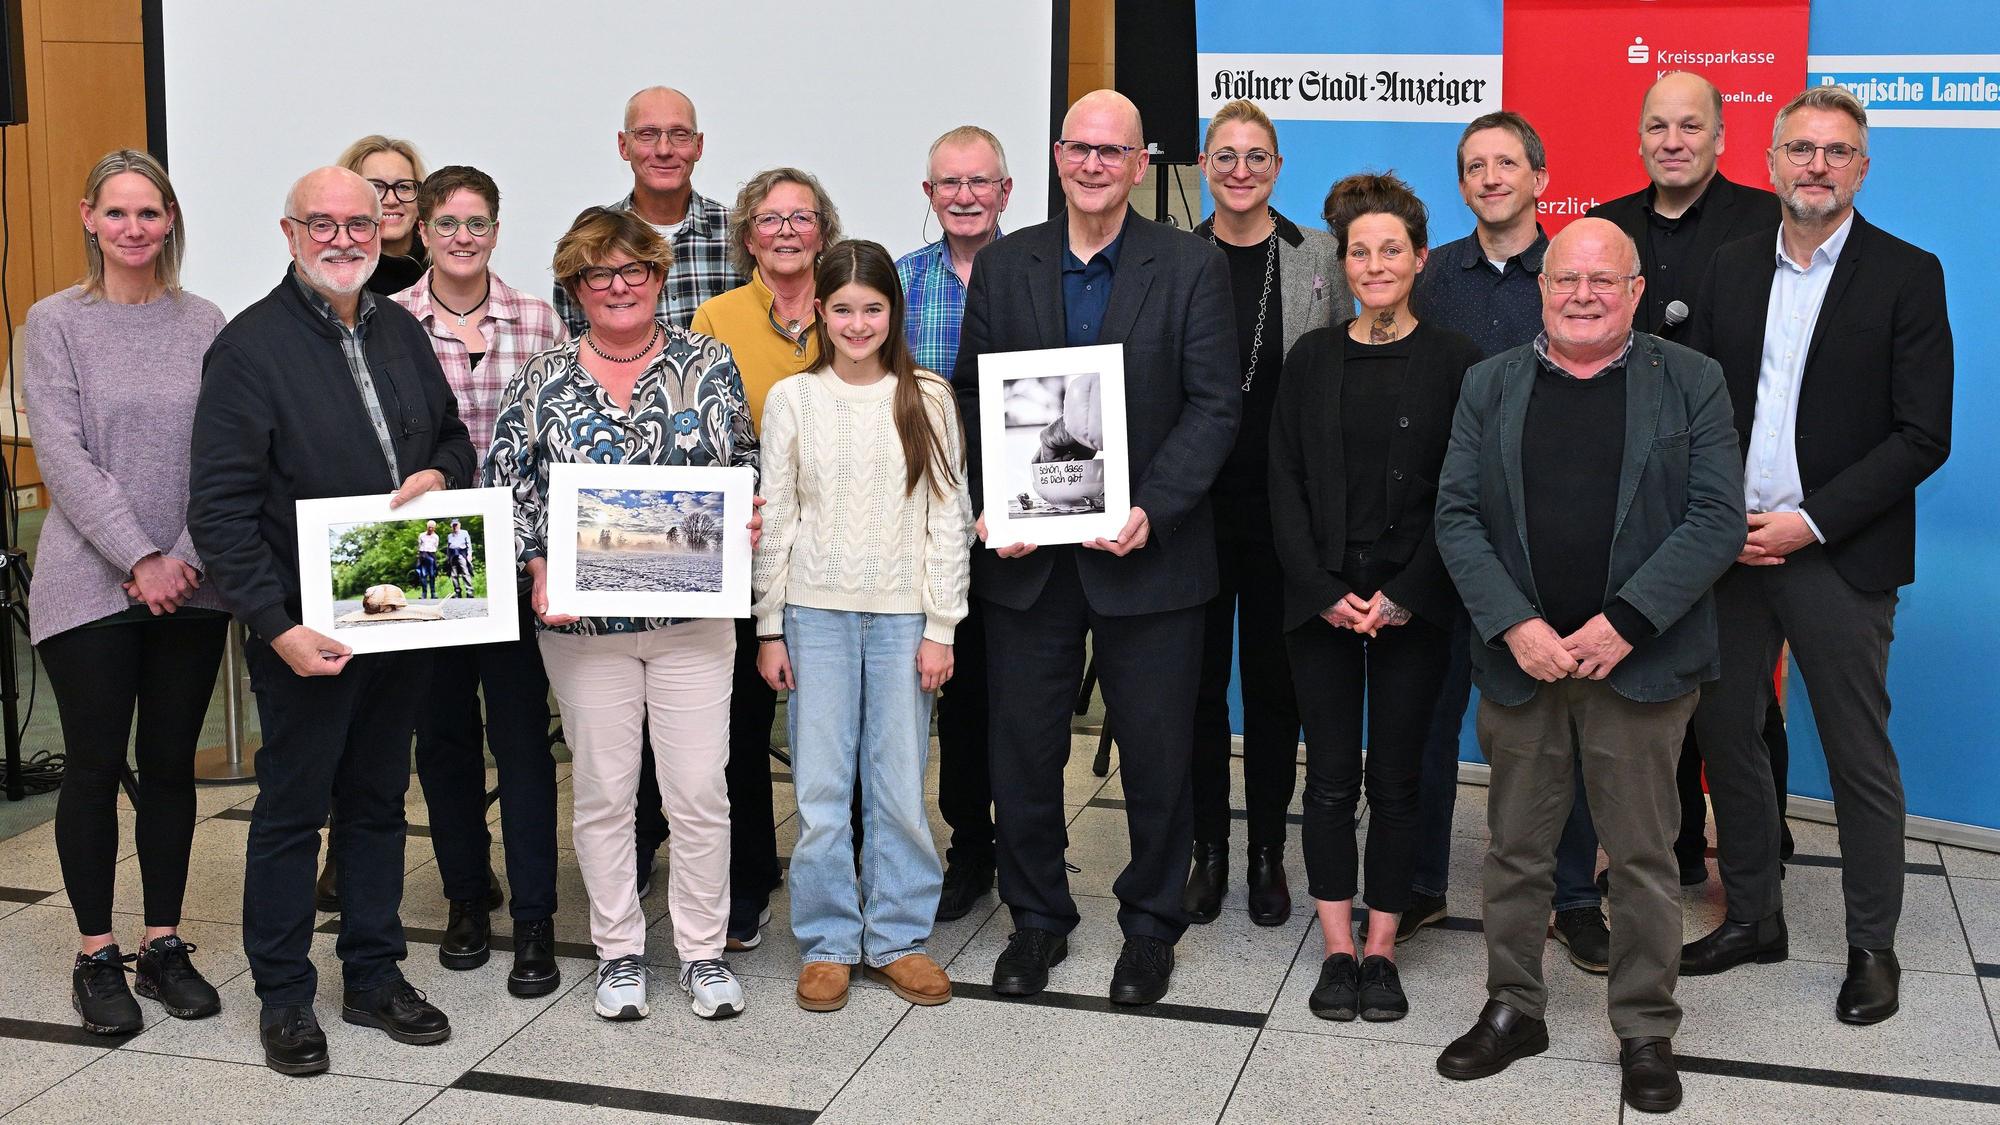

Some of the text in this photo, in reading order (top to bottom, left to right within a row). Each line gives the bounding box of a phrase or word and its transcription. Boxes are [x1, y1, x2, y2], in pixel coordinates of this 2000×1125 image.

[1657, 50, 1775, 66] Kreissparkasse
[1211, 69, 1487, 106] Kölner Stadt-Anzeiger
[1537, 197, 1600, 214] erzlich
[1064, 464, 1083, 473] dass
[1067, 473, 1084, 486] gibt
